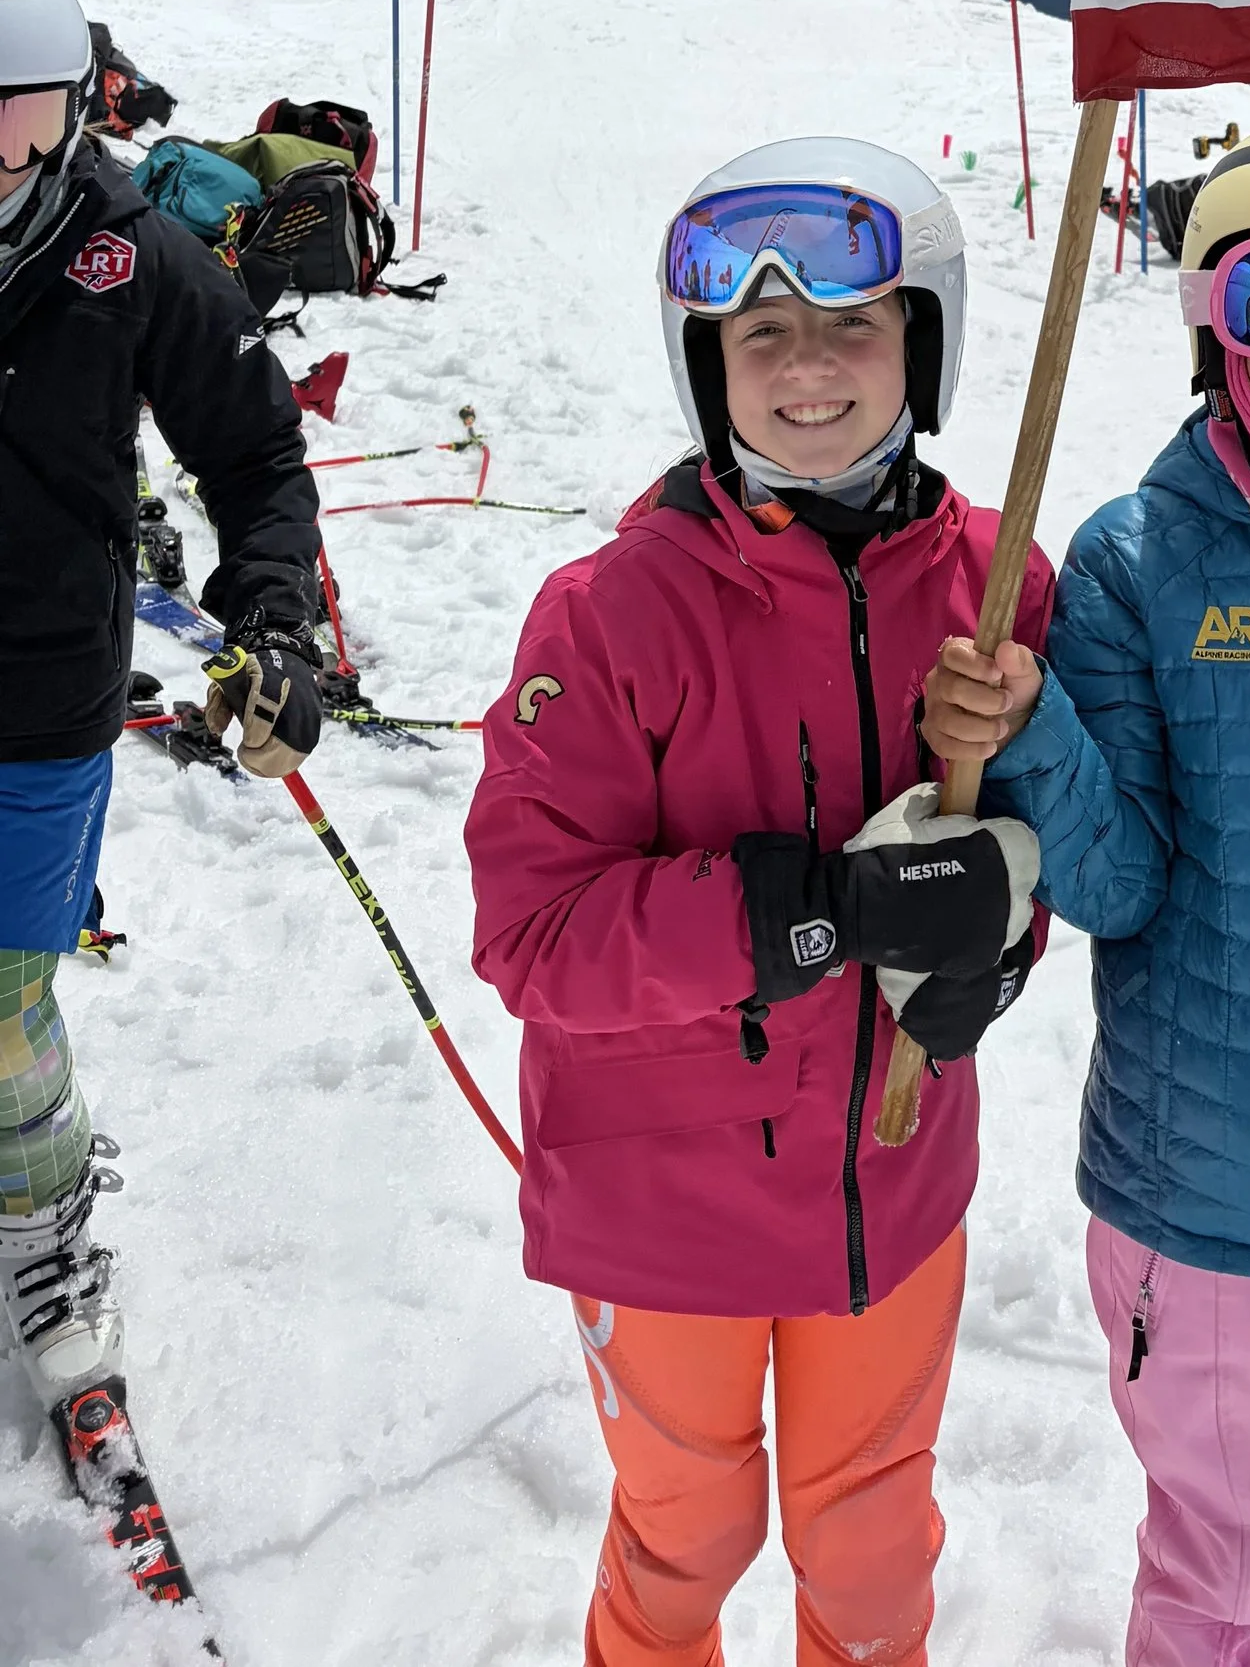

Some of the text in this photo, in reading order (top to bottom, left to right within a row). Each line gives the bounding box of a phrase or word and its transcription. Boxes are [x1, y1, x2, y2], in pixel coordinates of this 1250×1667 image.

[74, 251, 130, 273] LRT
[1195, 651, 1223, 659] ALPINE
[899, 859, 966, 882] HESTRA
[336, 851, 388, 926] LEKI
